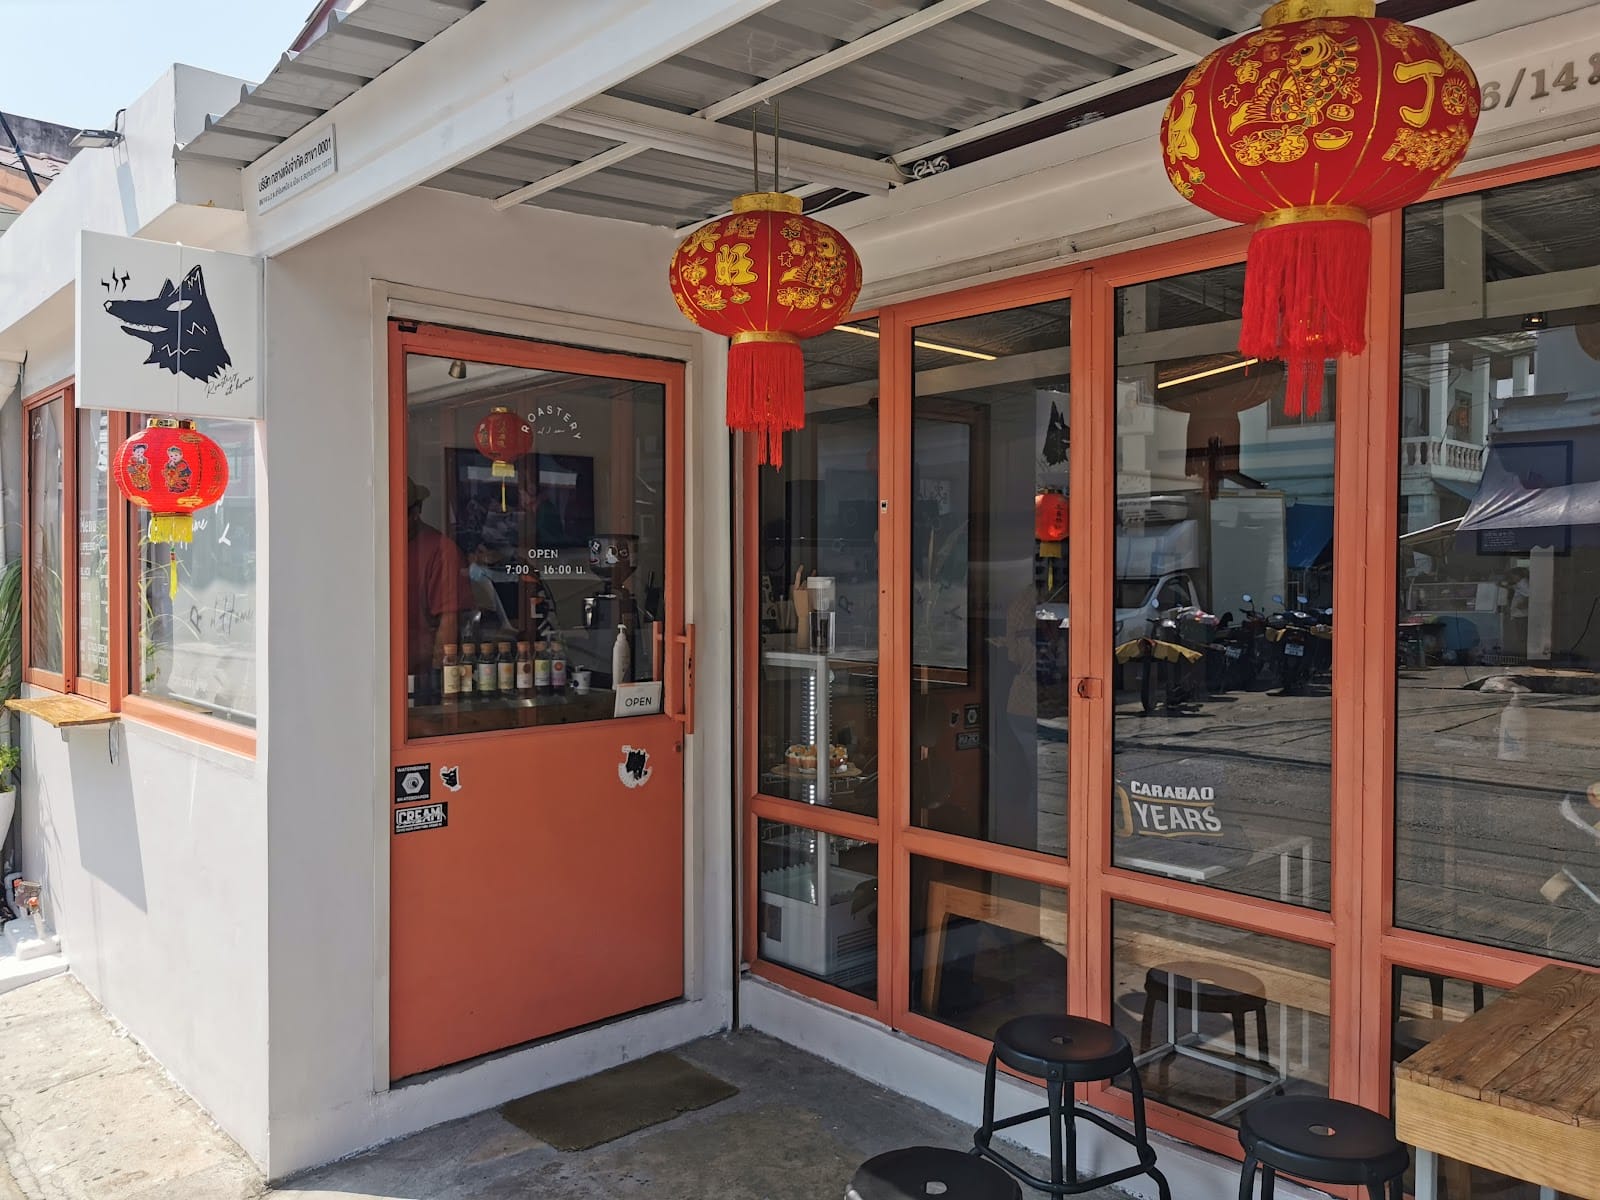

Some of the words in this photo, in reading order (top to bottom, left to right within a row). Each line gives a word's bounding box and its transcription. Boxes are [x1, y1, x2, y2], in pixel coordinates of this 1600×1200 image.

[521, 405, 582, 439] ROASTERY
[528, 549, 559, 559] OPEN
[505, 565, 529, 574] 7:00
[543, 565, 572, 575] 16:00
[625, 696, 652, 707] OPEN
[1130, 780, 1215, 801] CARABAO
[399, 807, 441, 825] CREAM
[1133, 800, 1222, 832] YEARS
